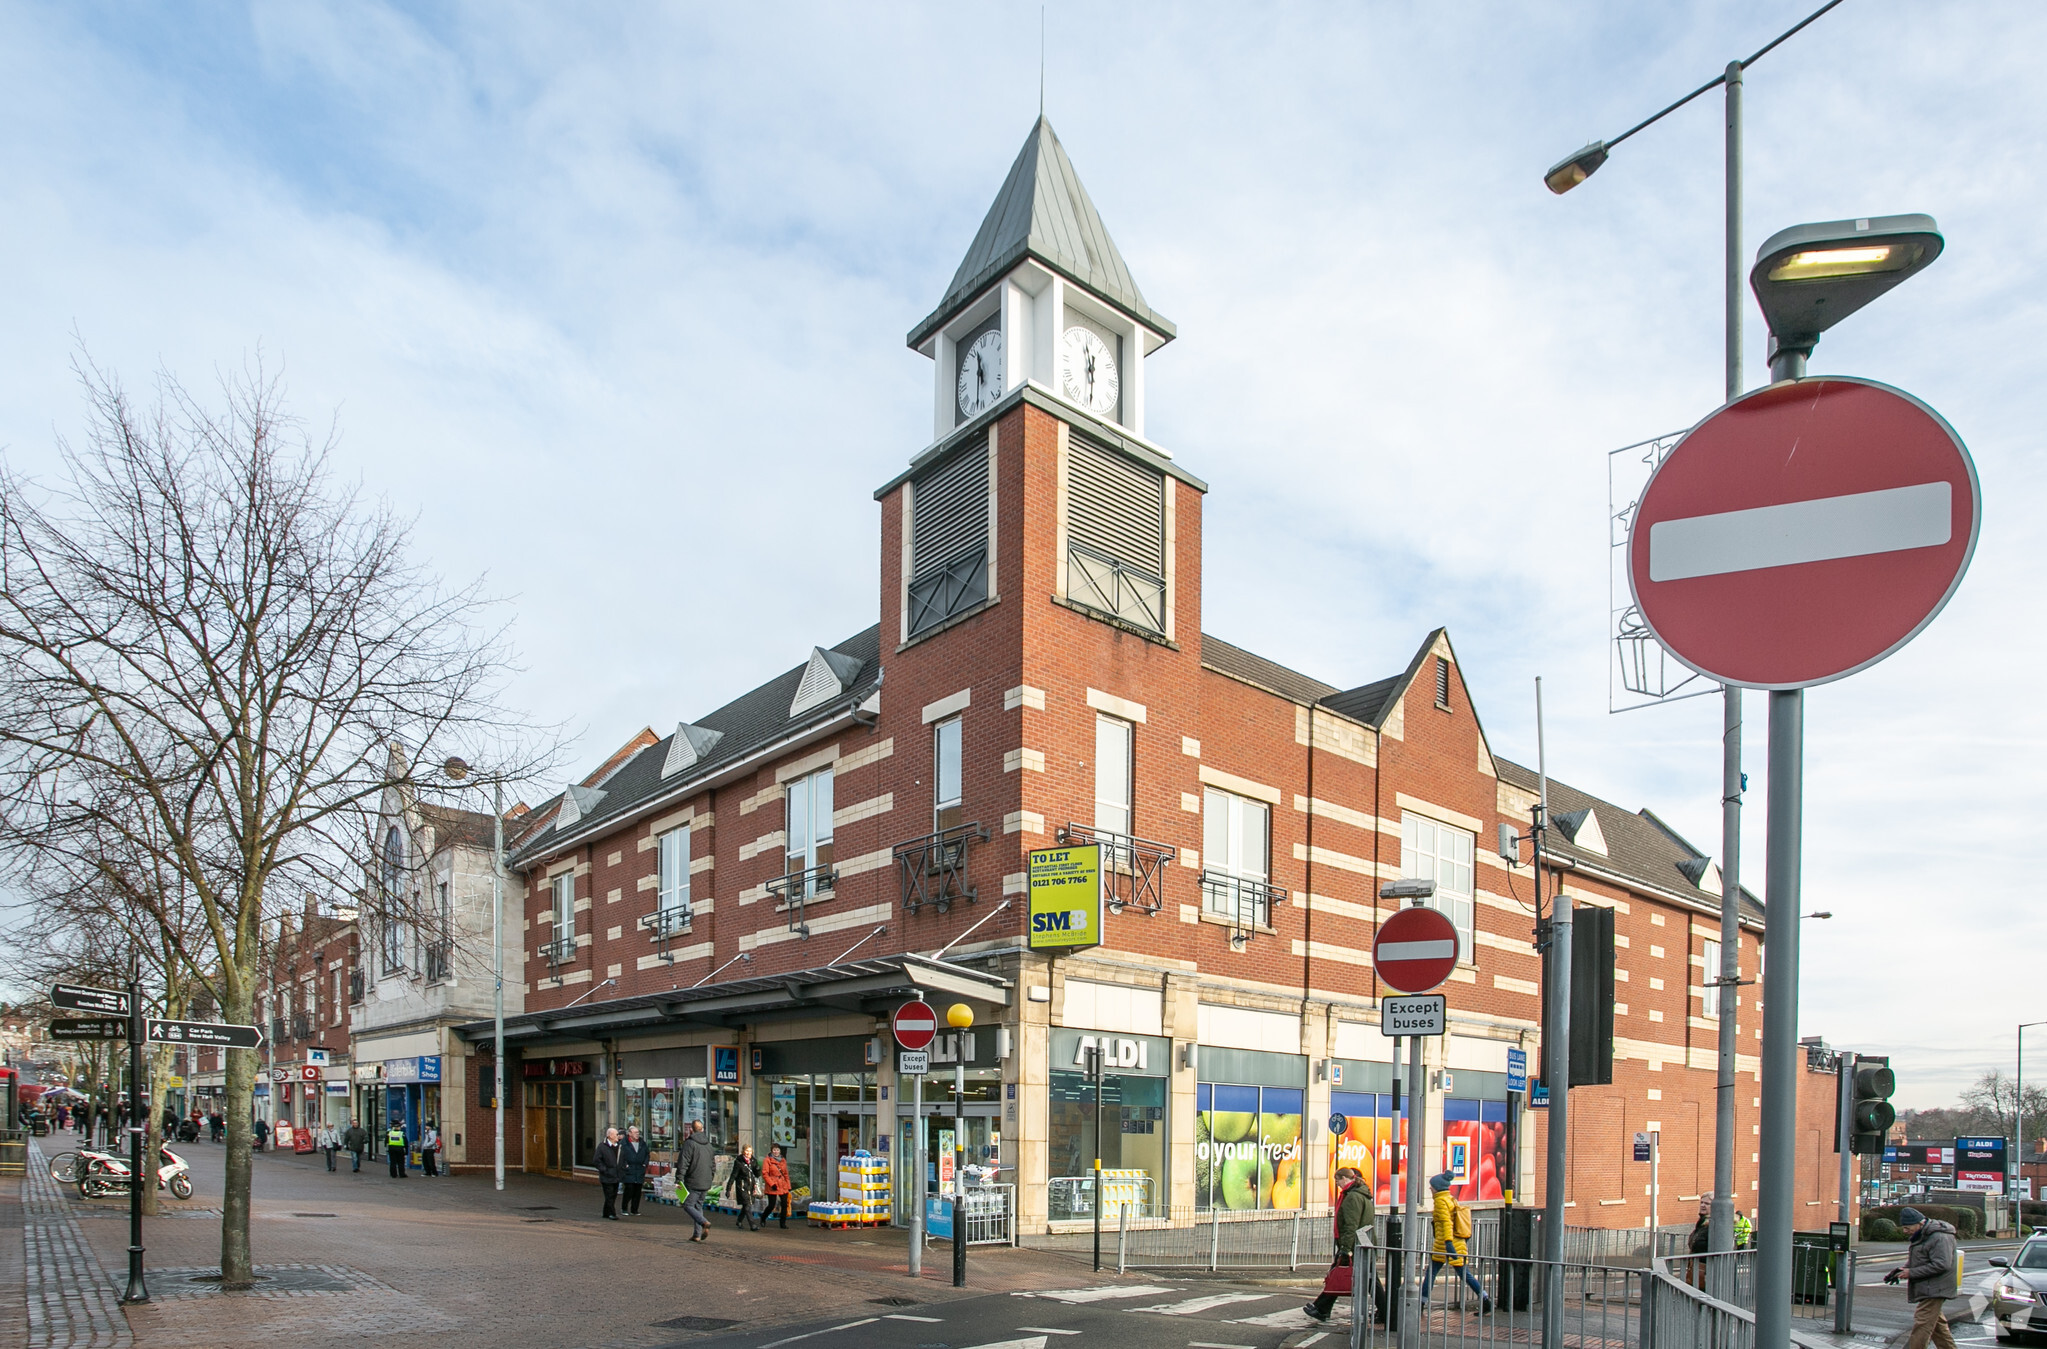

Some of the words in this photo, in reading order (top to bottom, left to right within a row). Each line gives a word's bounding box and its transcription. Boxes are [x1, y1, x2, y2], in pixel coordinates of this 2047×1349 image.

[1032, 854, 1047, 864] TO
[1049, 852, 1070, 863] LET
[1032, 879, 1050, 887] 0121
[1052, 878, 1066, 886] 706
[1068, 876, 1088, 884] 7766
[1032, 910, 1088, 932] SMB
[1390, 1001, 1439, 1014] Except
[1394, 1018, 1434, 1028] buses
[1074, 1035, 1148, 1069] ALDI
[1517, 1053, 1525, 1061] LANE
[902, 1054, 926, 1062] Except
[717, 1071, 737, 1080] ALDI
[1509, 1078, 1517, 1086] LOOK
[1213, 1142, 1257, 1166] your
[1260, 1134, 1301, 1164] fresh
[1334, 1136, 1366, 1168] shop
